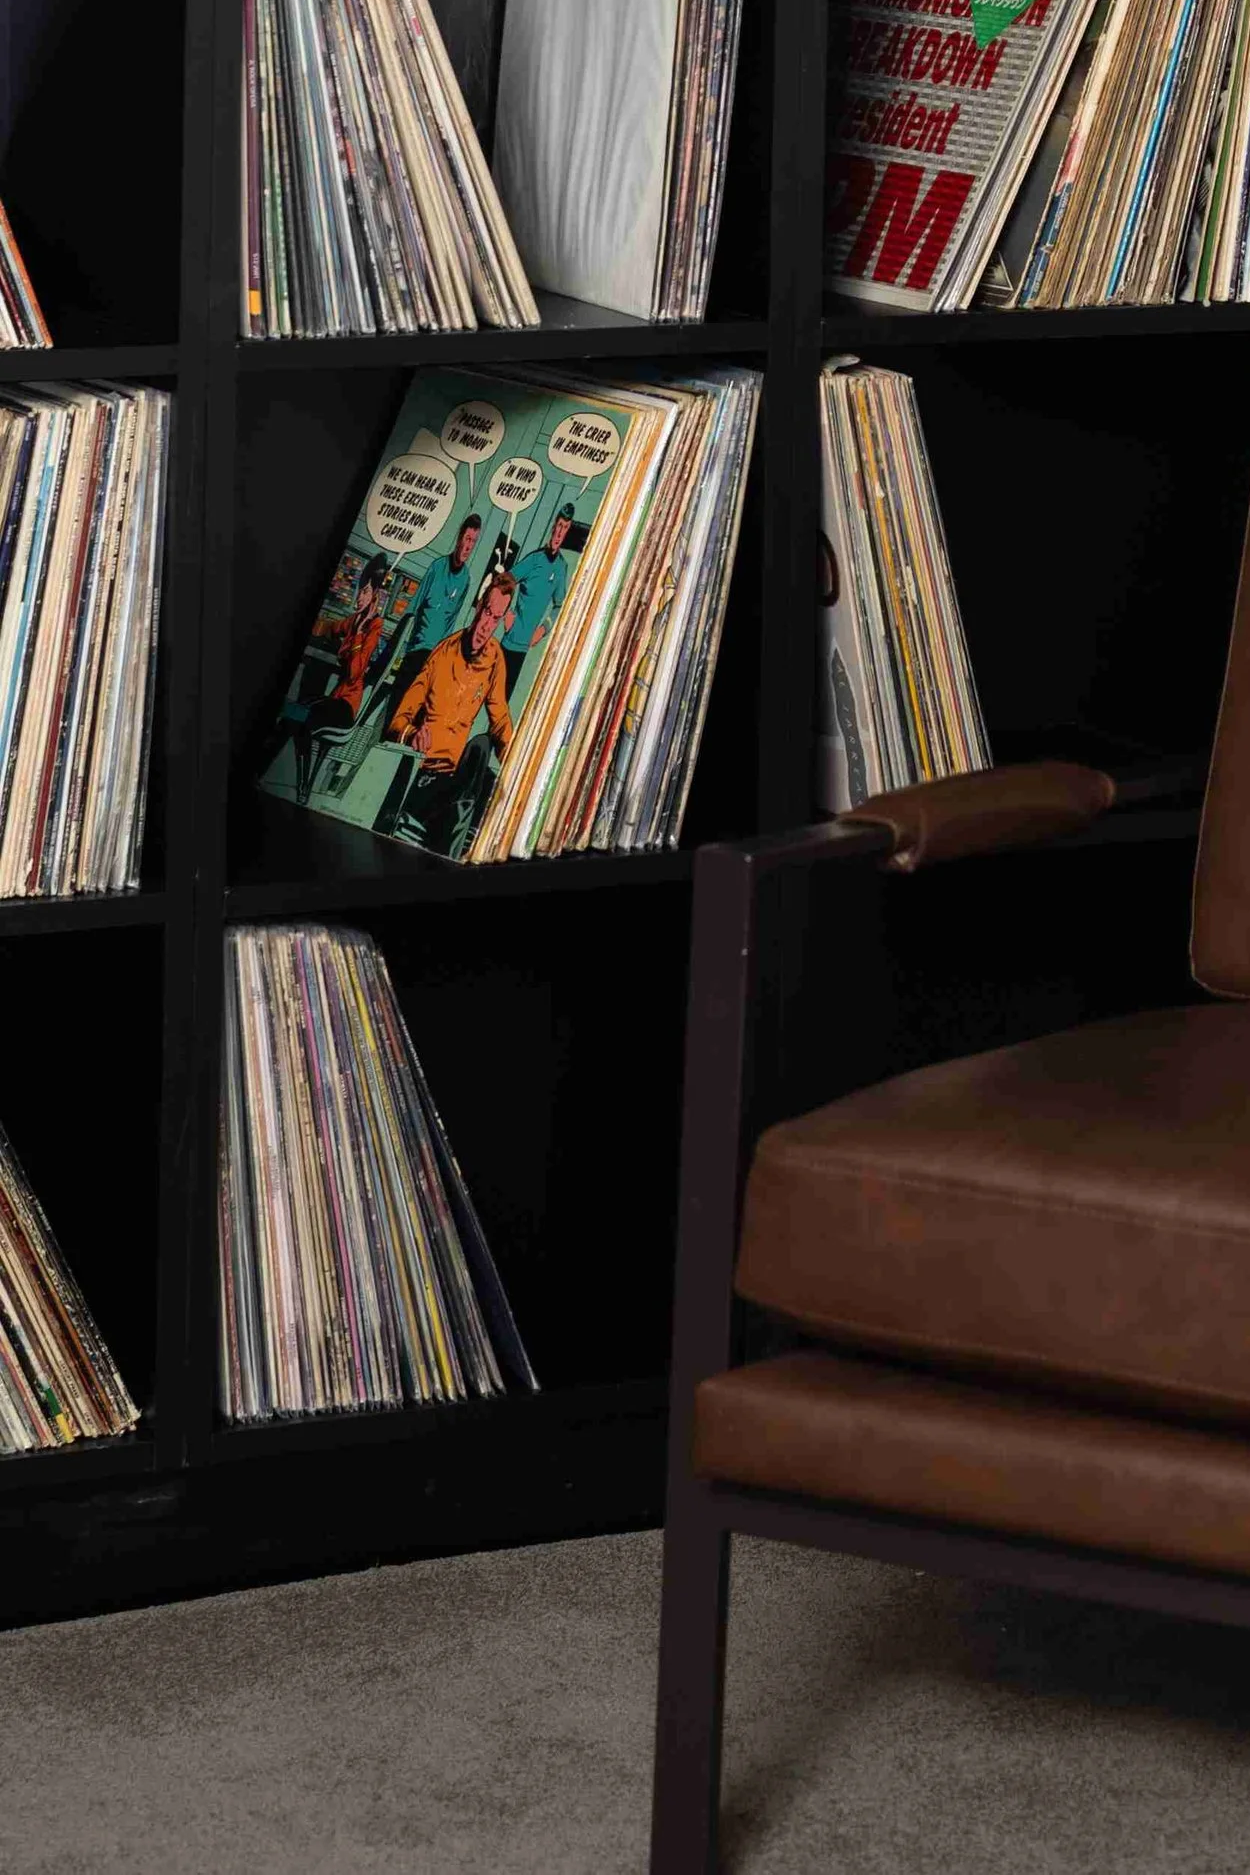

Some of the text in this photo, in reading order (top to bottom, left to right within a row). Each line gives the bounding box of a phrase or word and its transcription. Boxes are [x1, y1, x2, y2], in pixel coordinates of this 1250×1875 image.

[446, 428, 460, 442] TO
[552, 436, 565, 449] IN
[584, 425, 611, 444] CRIER
[387, 466, 452, 496] WE CAN HEAR ALL
[515, 466, 537, 483] VINO
[379, 484, 439, 512] THESE EXCITING
[377, 503, 412, 523] STORIES
